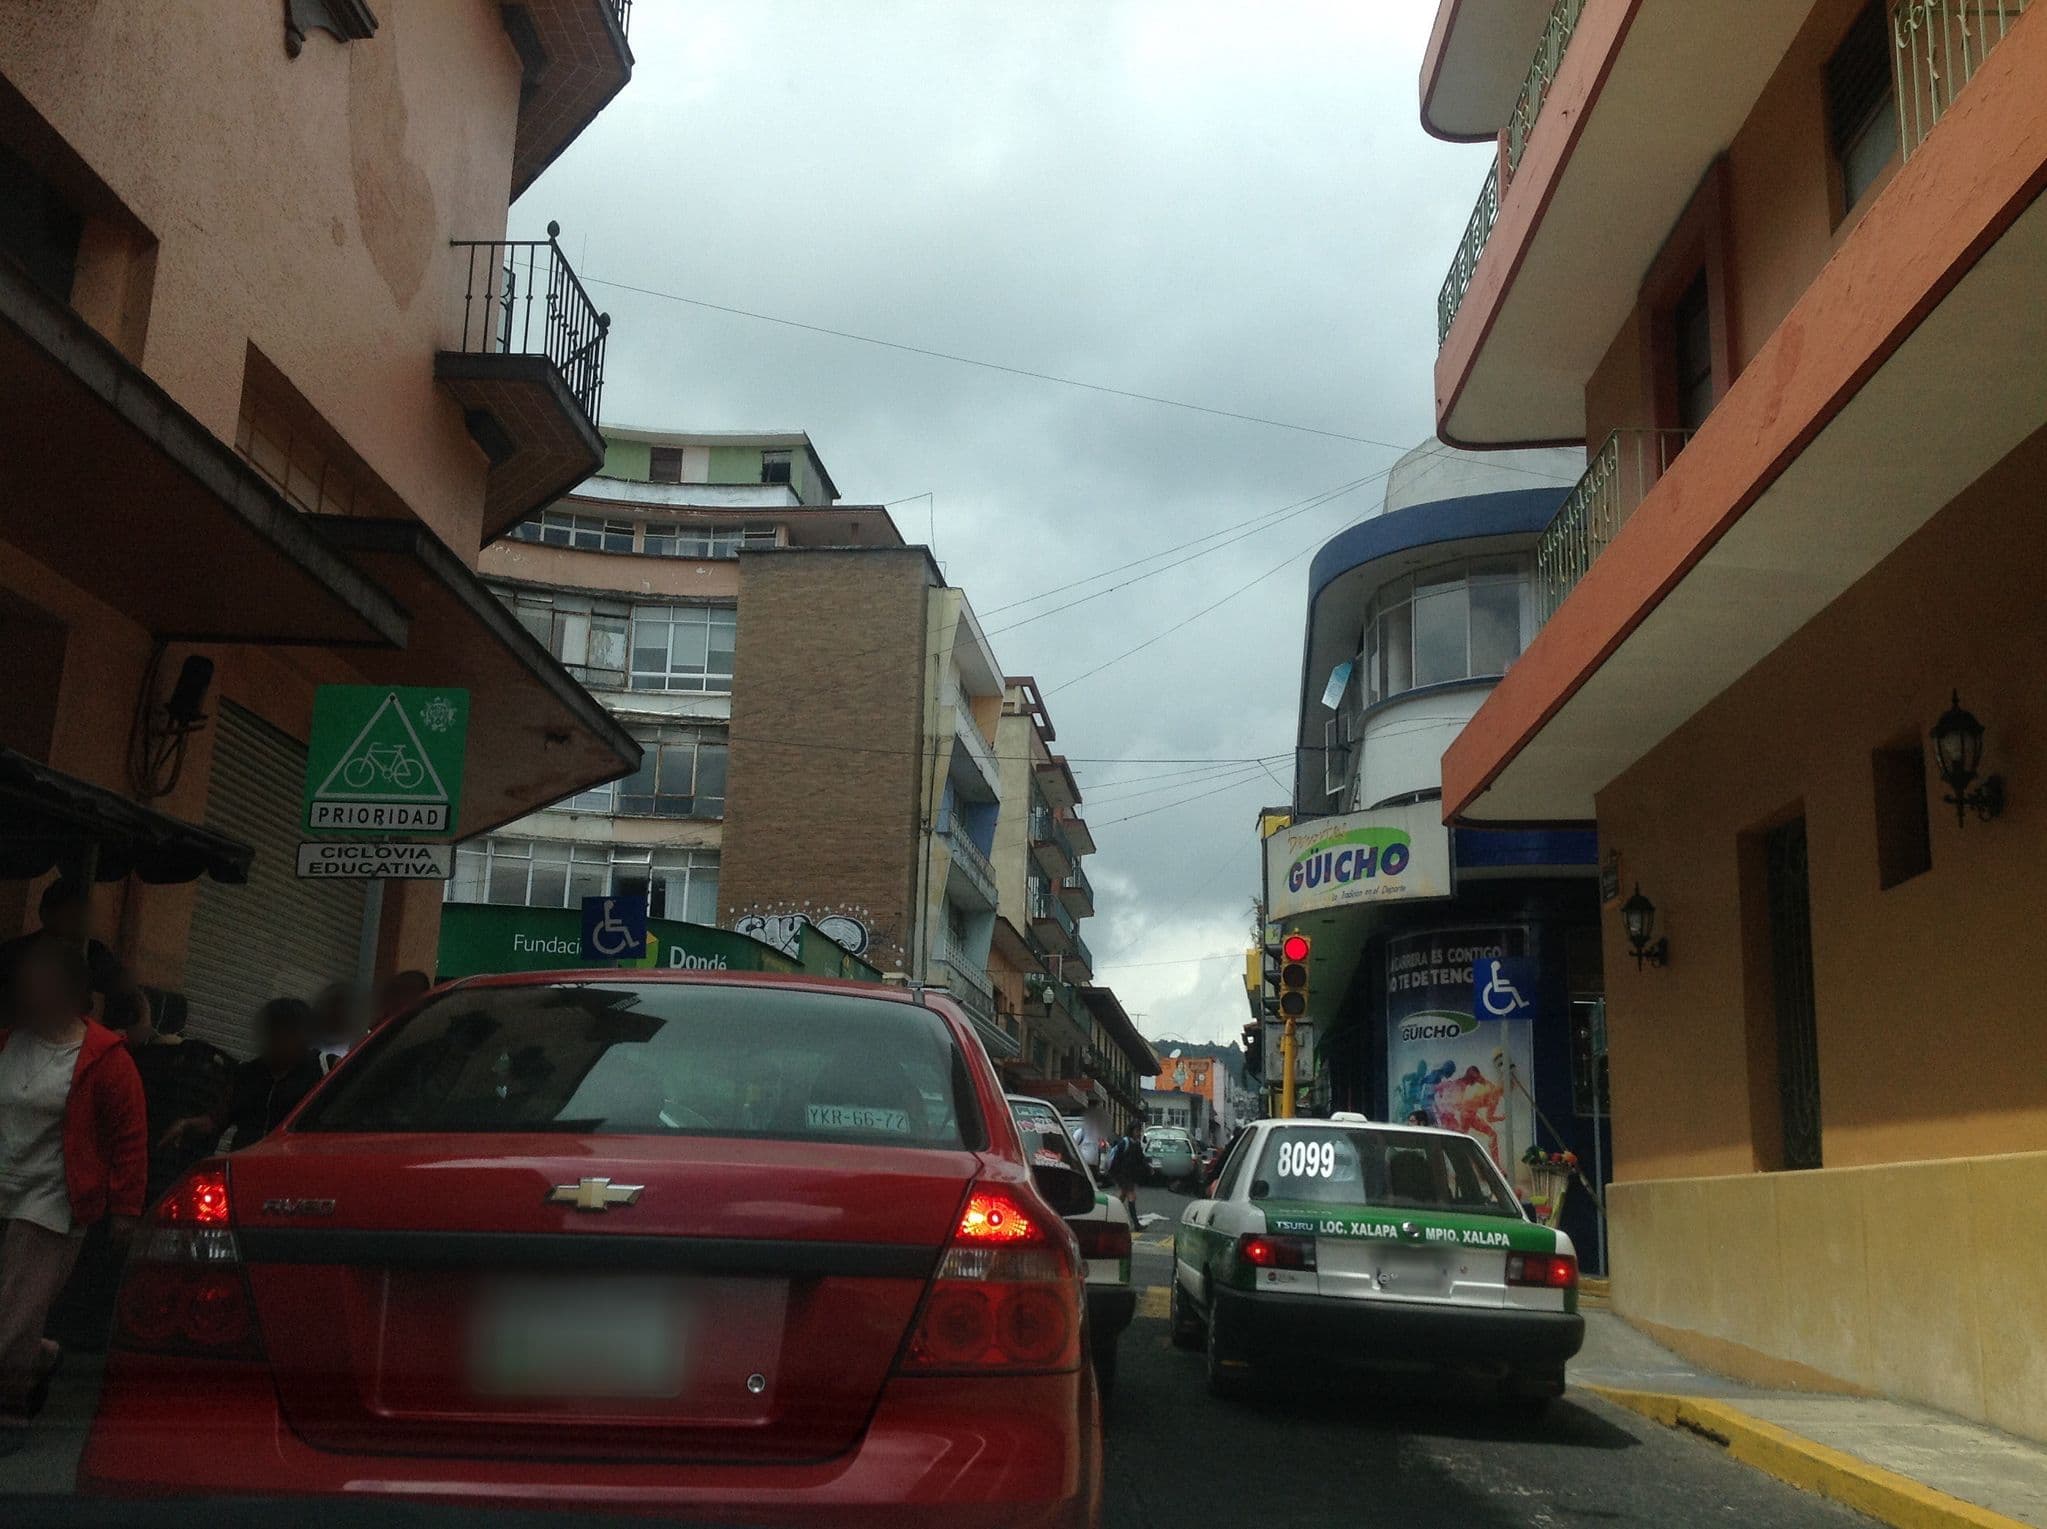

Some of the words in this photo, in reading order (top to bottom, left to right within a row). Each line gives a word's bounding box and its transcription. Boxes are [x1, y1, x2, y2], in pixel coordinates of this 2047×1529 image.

[318, 807, 438, 825] PRIORIDAD
[320, 846, 431, 859] CICLOVIA
[309, 862, 442, 875] EDUCATIVA
[1288, 842, 1410, 893] GÜICHO
[513, 933, 583, 955] Fundaci
[669, 945, 728, 970] Dondé
[1447, 946, 1503, 964] CONTIGO
[1277, 1141, 1335, 1178] 8099
[1275, 1221, 1314, 1231] TSURU
[1319, 1220, 1348, 1234] LOC.
[1350, 1222, 1398, 1239] XALAPA
[1425, 1227, 1460, 1242] MPIO.
[1462, 1230, 1511, 1247] XALAPA
